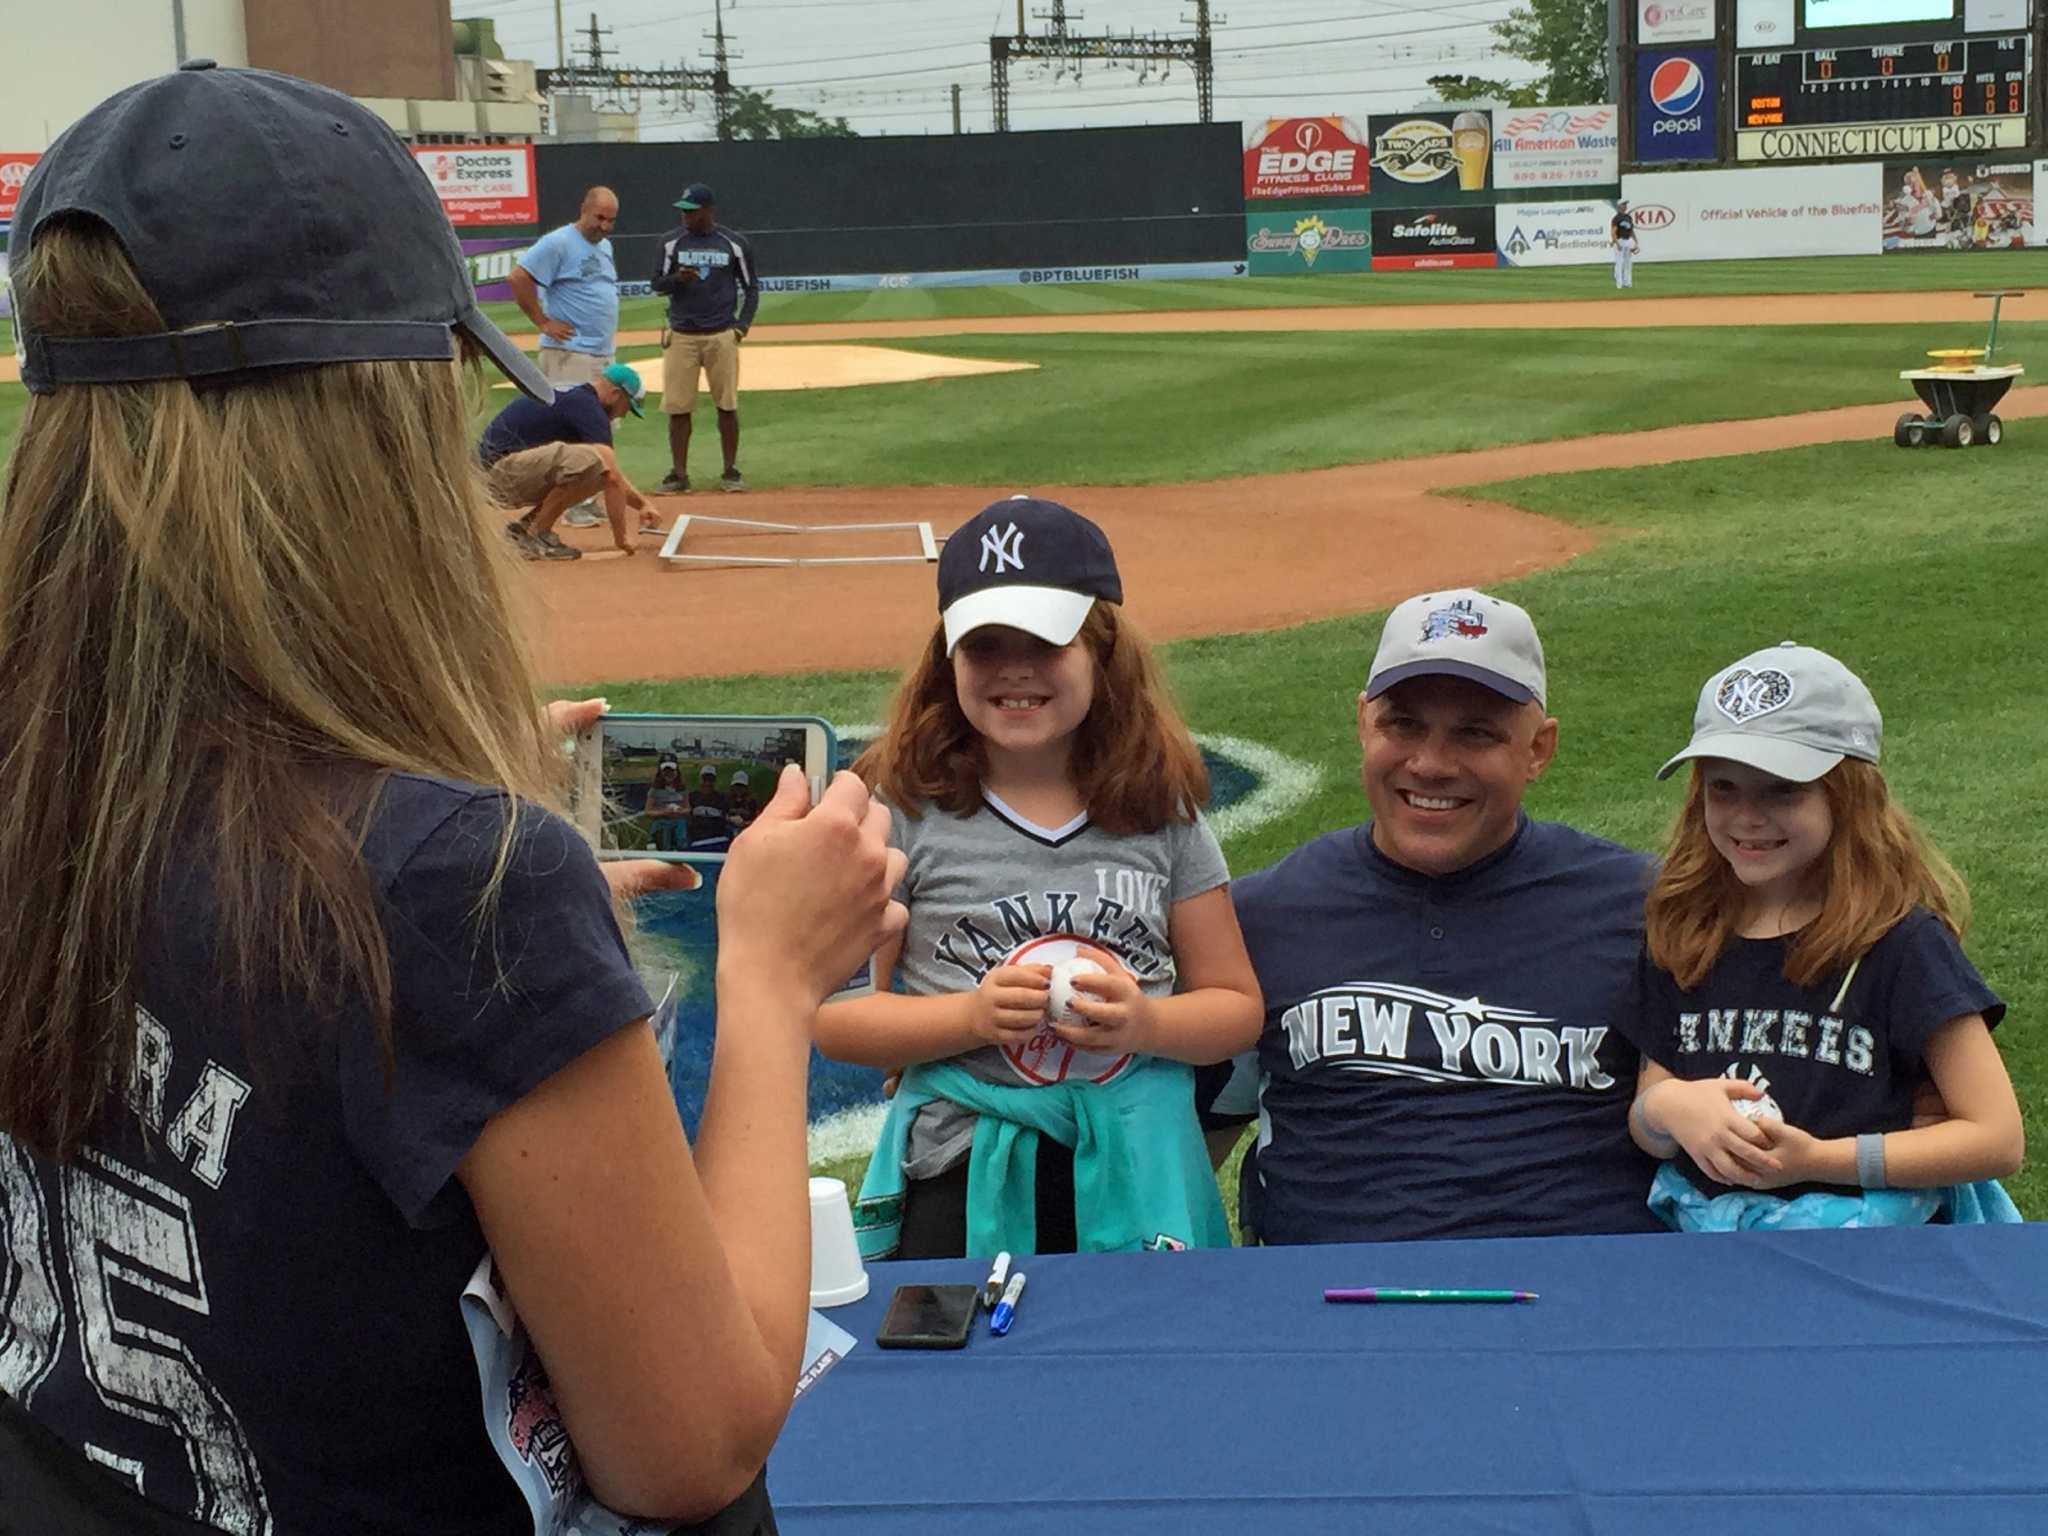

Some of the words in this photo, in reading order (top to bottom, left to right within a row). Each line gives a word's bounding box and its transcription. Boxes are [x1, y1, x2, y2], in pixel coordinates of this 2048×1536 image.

[1872, 46, 1905, 58] STRIKE
[1933, 42, 1952, 54] OUT
[1752, 56, 1763, 65] AT
[1765, 54, 1781, 65] BAT
[1814, 51, 1837, 62] BALL
[1920, 77, 1930, 86] 10
[1652, 116, 1701, 136] pepsi
[1494, 138, 1512, 152] All
[1515, 136, 1576, 151] American
[1577, 135, 1617, 149] Waste
[1760, 125, 1931, 158] CONNECTICUT
[1937, 122, 2003, 150] POST
[1387, 140, 1411, 149] TWO
[1409, 139, 1449, 160] ROADS
[456, 156, 512, 167] Doctors
[1258, 149, 1356, 174] EDGE
[456, 169, 512, 181] Express
[1257, 173, 1310, 184] FITNESS
[1314, 171, 1352, 182] CLUBS
[1634, 211, 1667, 224] KIA
[1700, 209, 1743, 221] Official
[1746, 207, 1788, 219] Vehicle
[1791, 207, 1804, 217] of
[1807, 206, 1828, 216] the
[1831, 205, 1880, 216] Bluefish
[1392, 223, 1458, 238] Safelite
[1533, 227, 1604, 242] Advanced
[1018, 268, 1139, 284] @BPTBLUEFISH
[978, 522, 1025, 573] NY
[1725, 677, 1769, 712] NY
[1095, 869, 1170, 916] LOVE
[1281, 996, 1413, 1071] NEW
[1425, 1011, 1616, 1089] YORK
